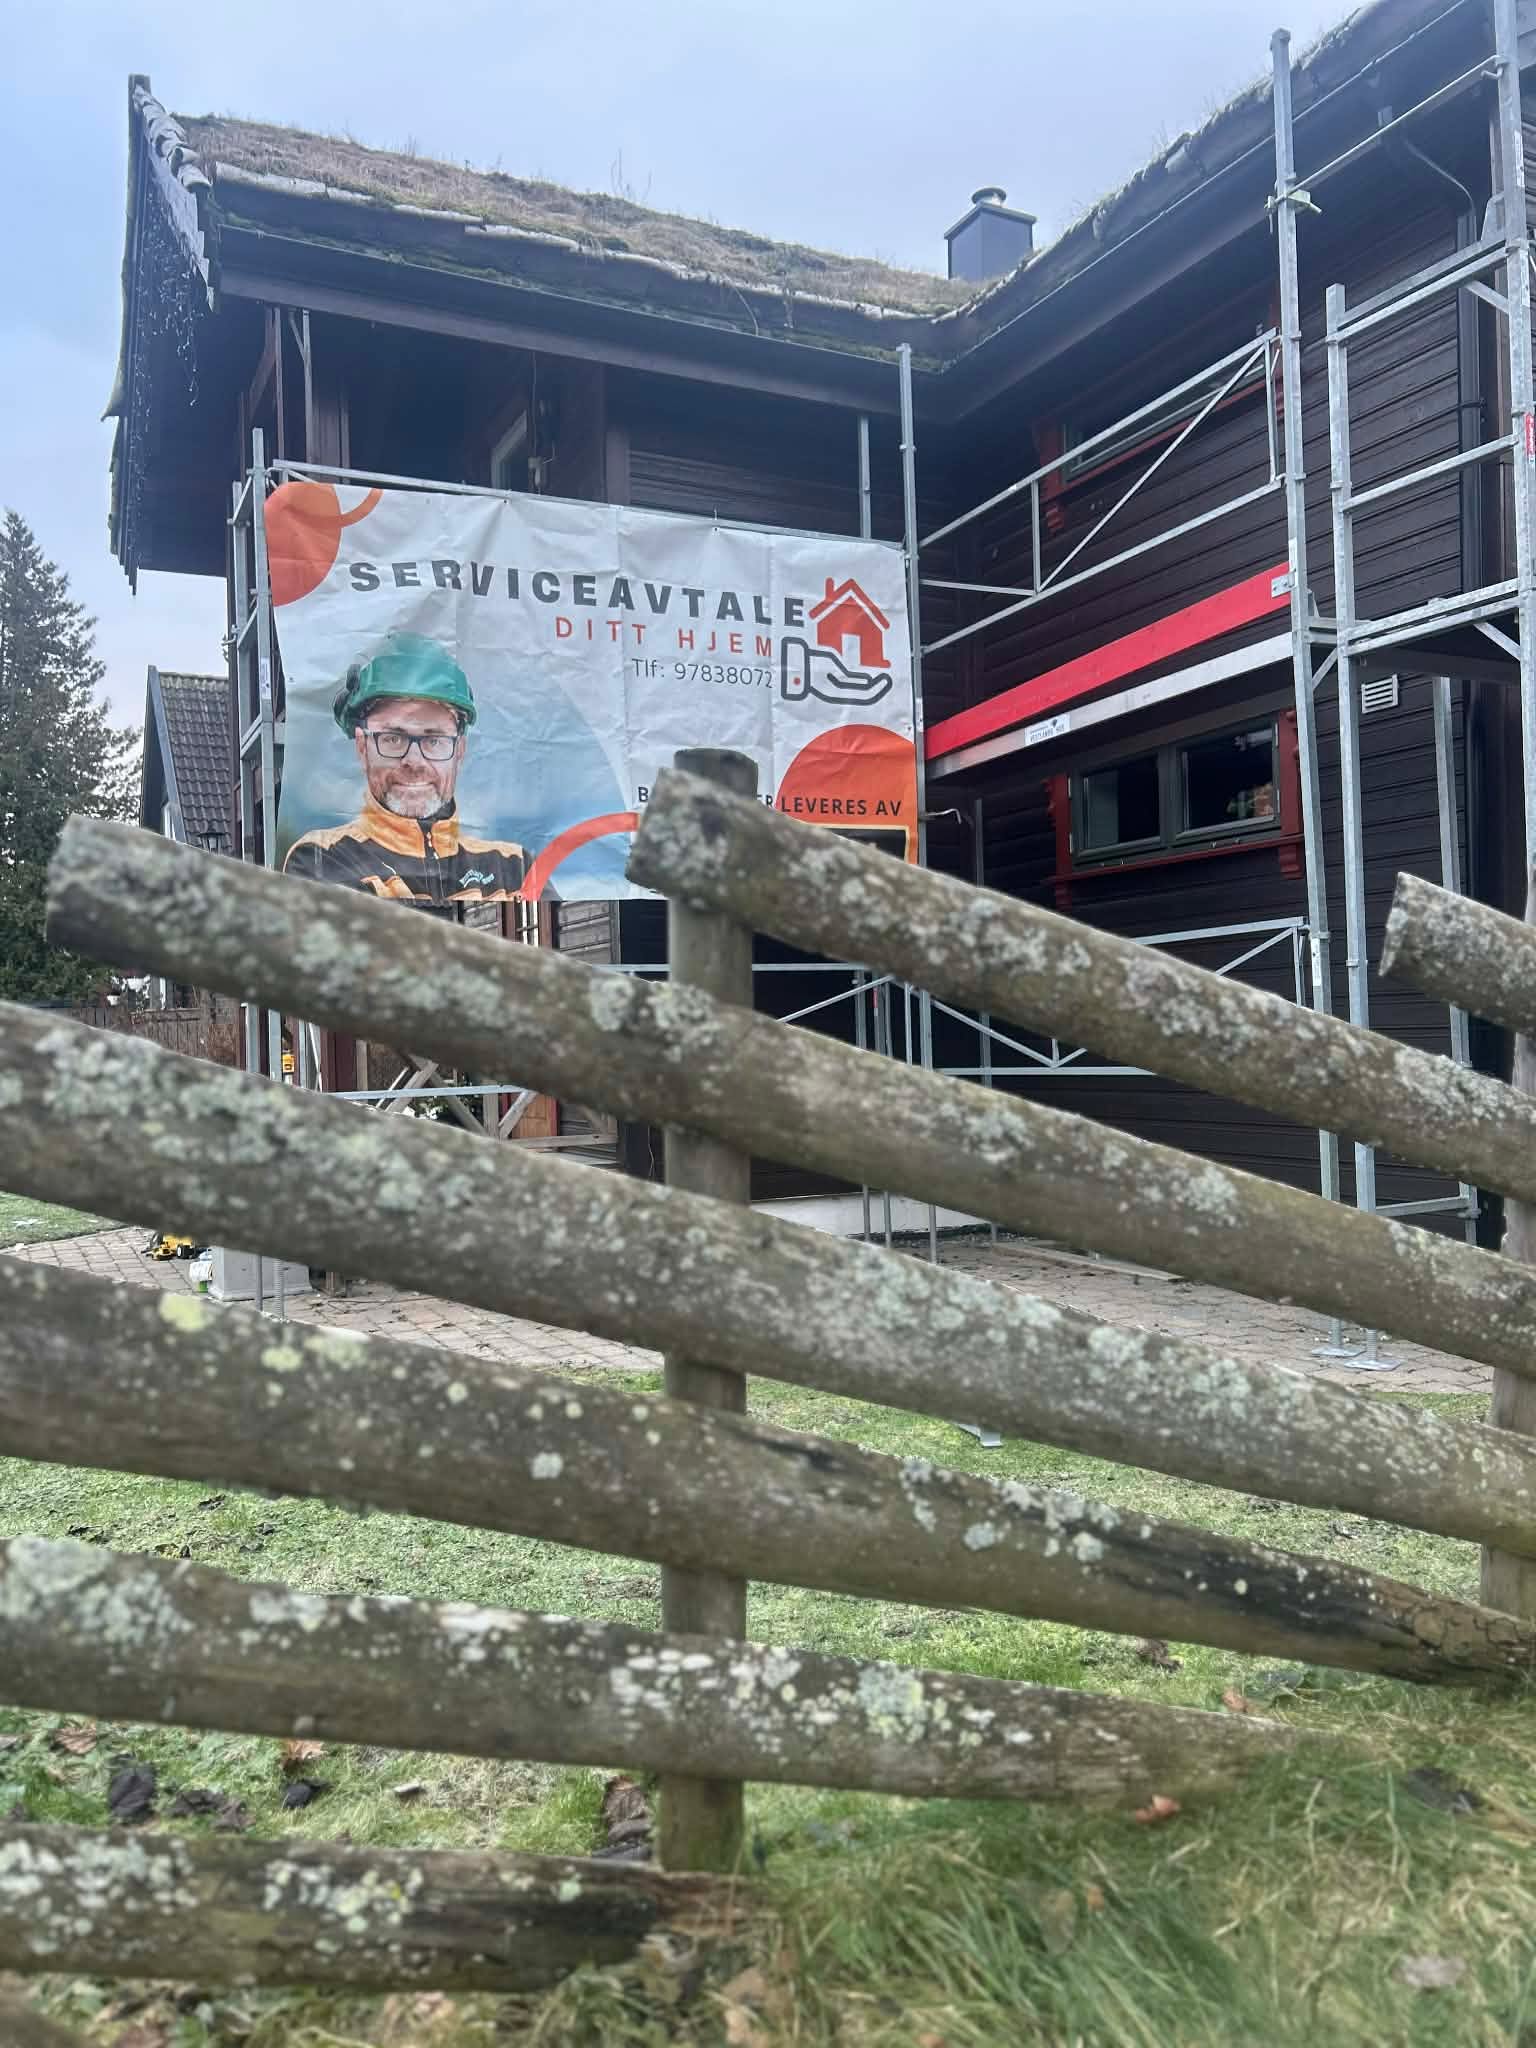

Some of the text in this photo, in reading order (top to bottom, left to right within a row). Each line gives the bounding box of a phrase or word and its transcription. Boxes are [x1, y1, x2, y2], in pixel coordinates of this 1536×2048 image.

[348, 559, 805, 627] SERVICEAVTALE
[555, 616, 772, 657] DITT HJEM
[631, 658, 773, 689] Tlf: 97838072
[781, 796, 867, 816] LEVERES
[875, 800, 903, 817] AV
